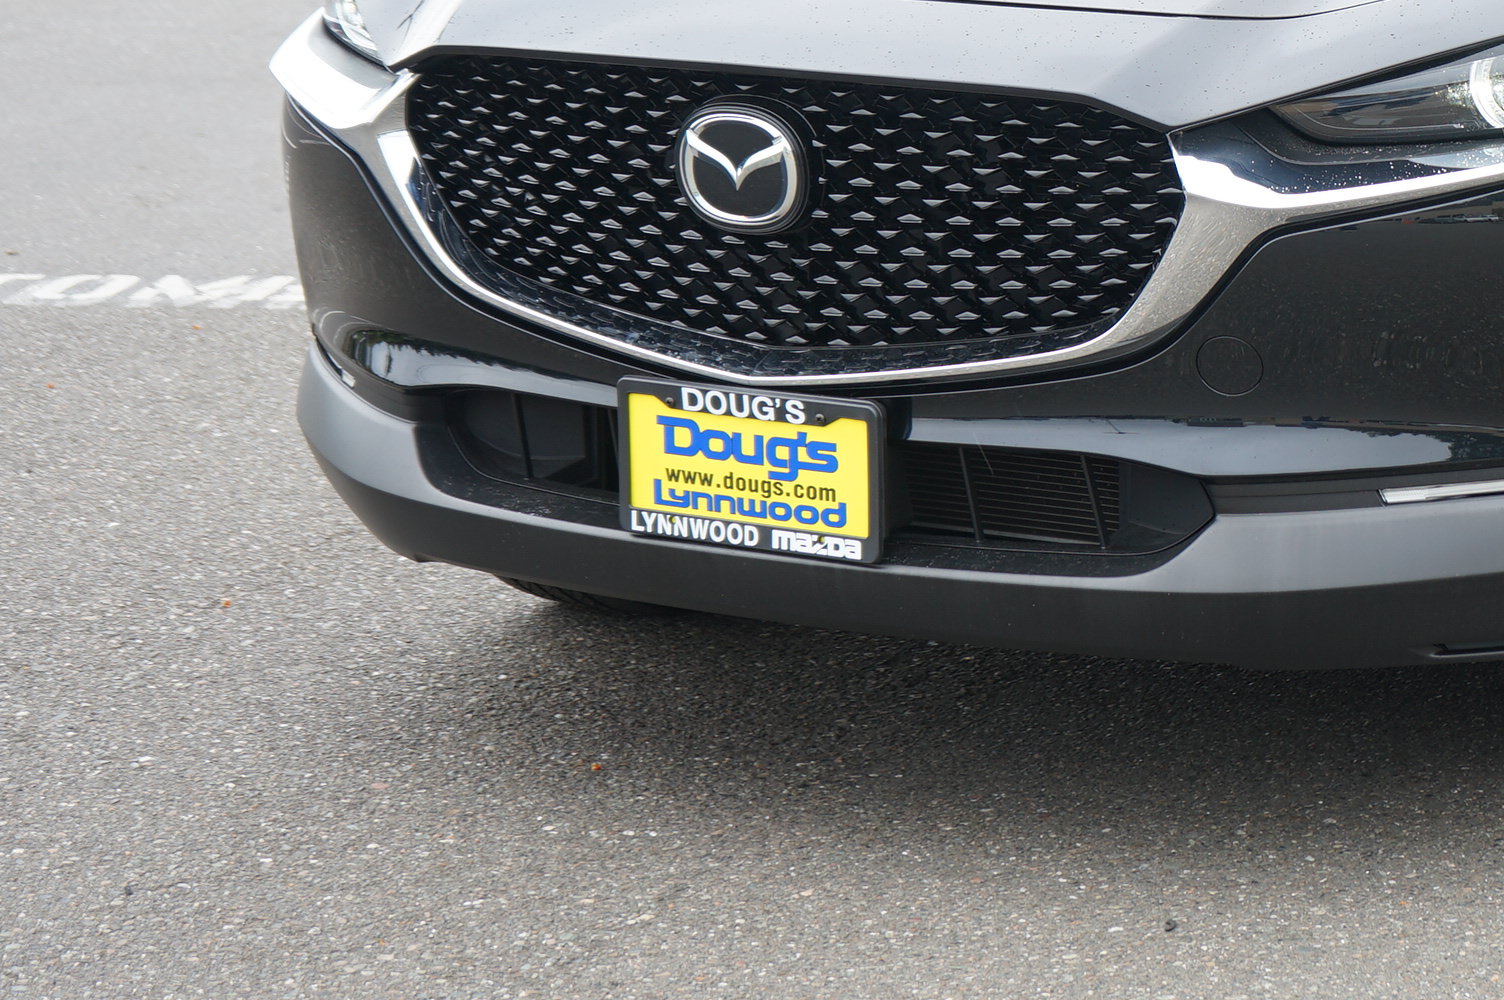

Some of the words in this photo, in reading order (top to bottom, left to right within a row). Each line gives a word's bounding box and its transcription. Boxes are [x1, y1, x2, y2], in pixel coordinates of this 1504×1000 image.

[680, 387, 806, 424] DOUG'S
[653, 478, 847, 528] Lynnwood
[665, 467, 836, 502] www.dougs.com
[631, 510, 759, 547] LYNNWOOD
